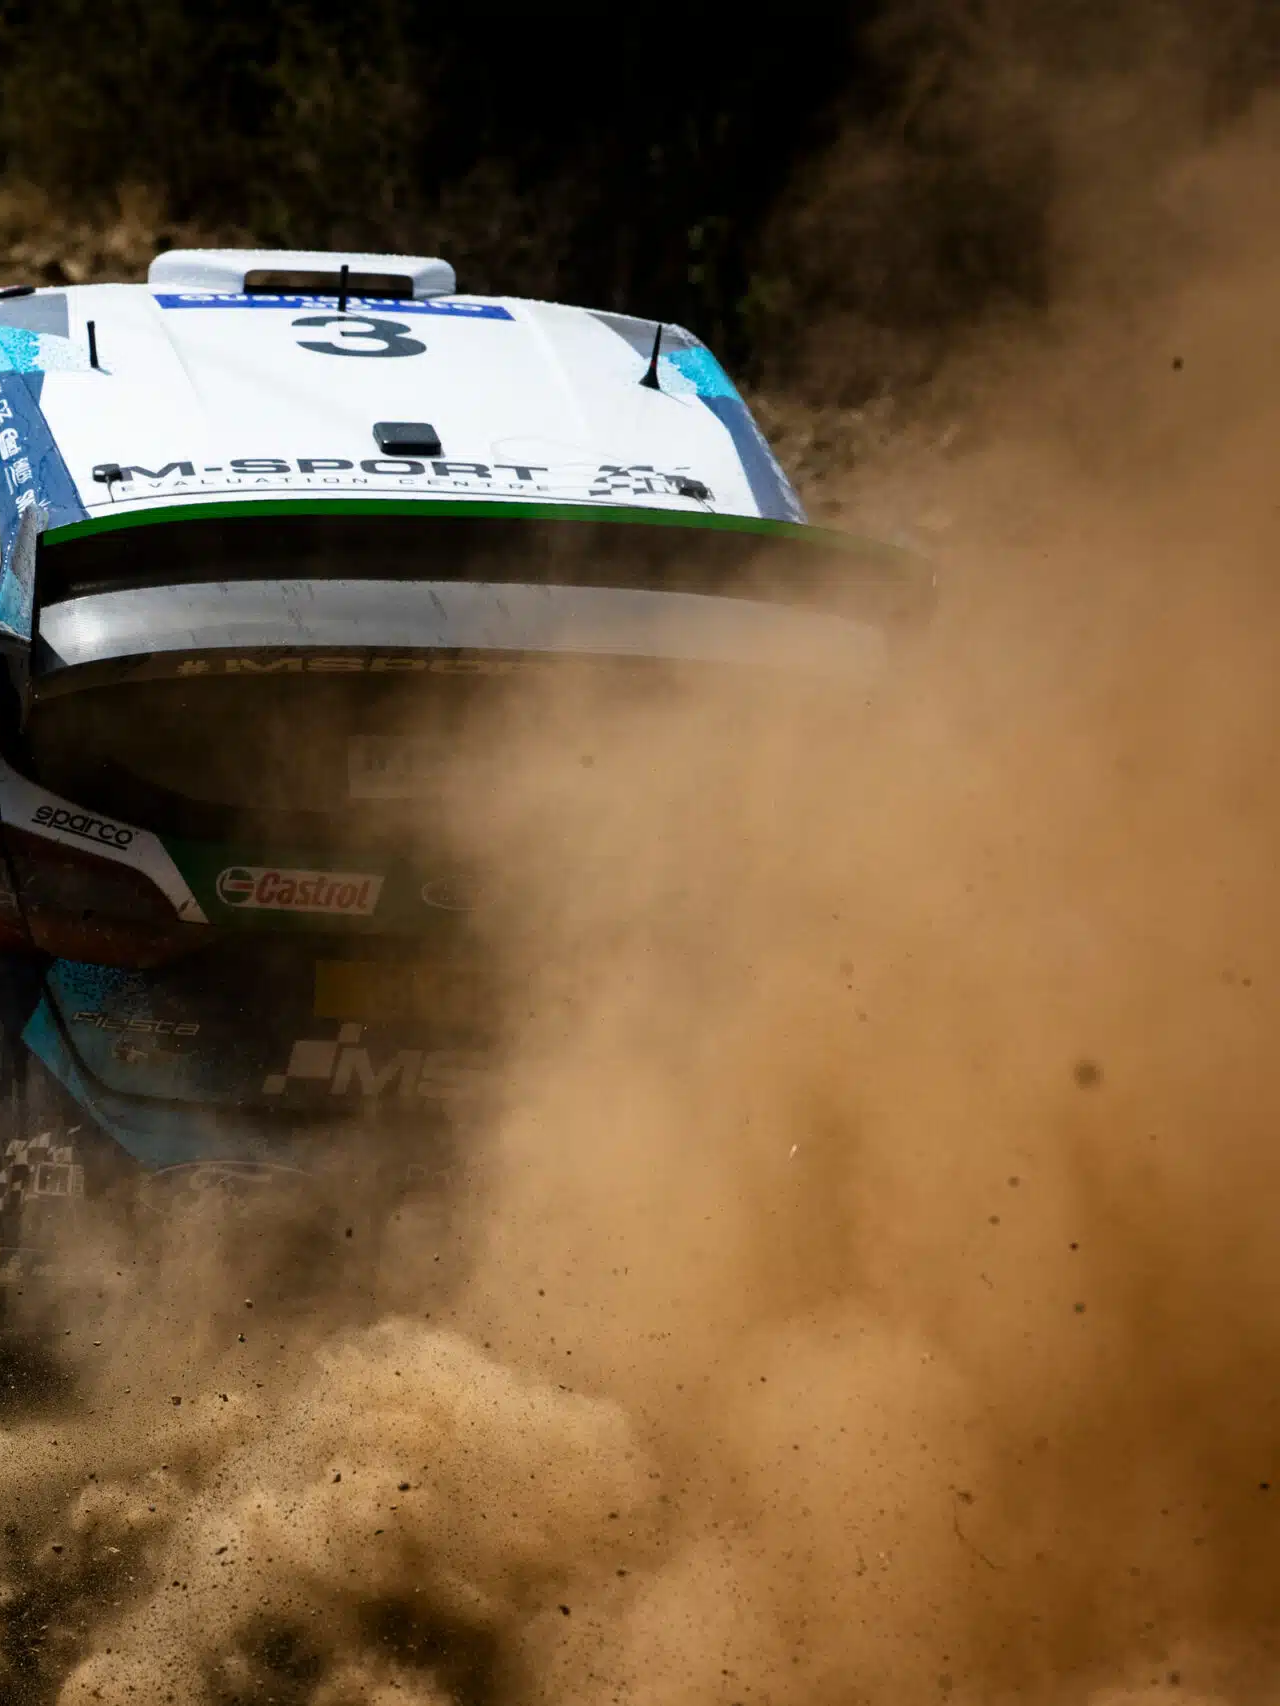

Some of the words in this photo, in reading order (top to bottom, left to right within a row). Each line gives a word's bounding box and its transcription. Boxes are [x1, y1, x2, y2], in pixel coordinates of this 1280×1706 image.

[291, 315, 427, 358] 3
[119, 458, 548, 482] M-SPORT
[121, 477, 368, 493] EVALUATION
[35, 805, 134, 845] sparco
[256, 871, 370, 910] Castrol
